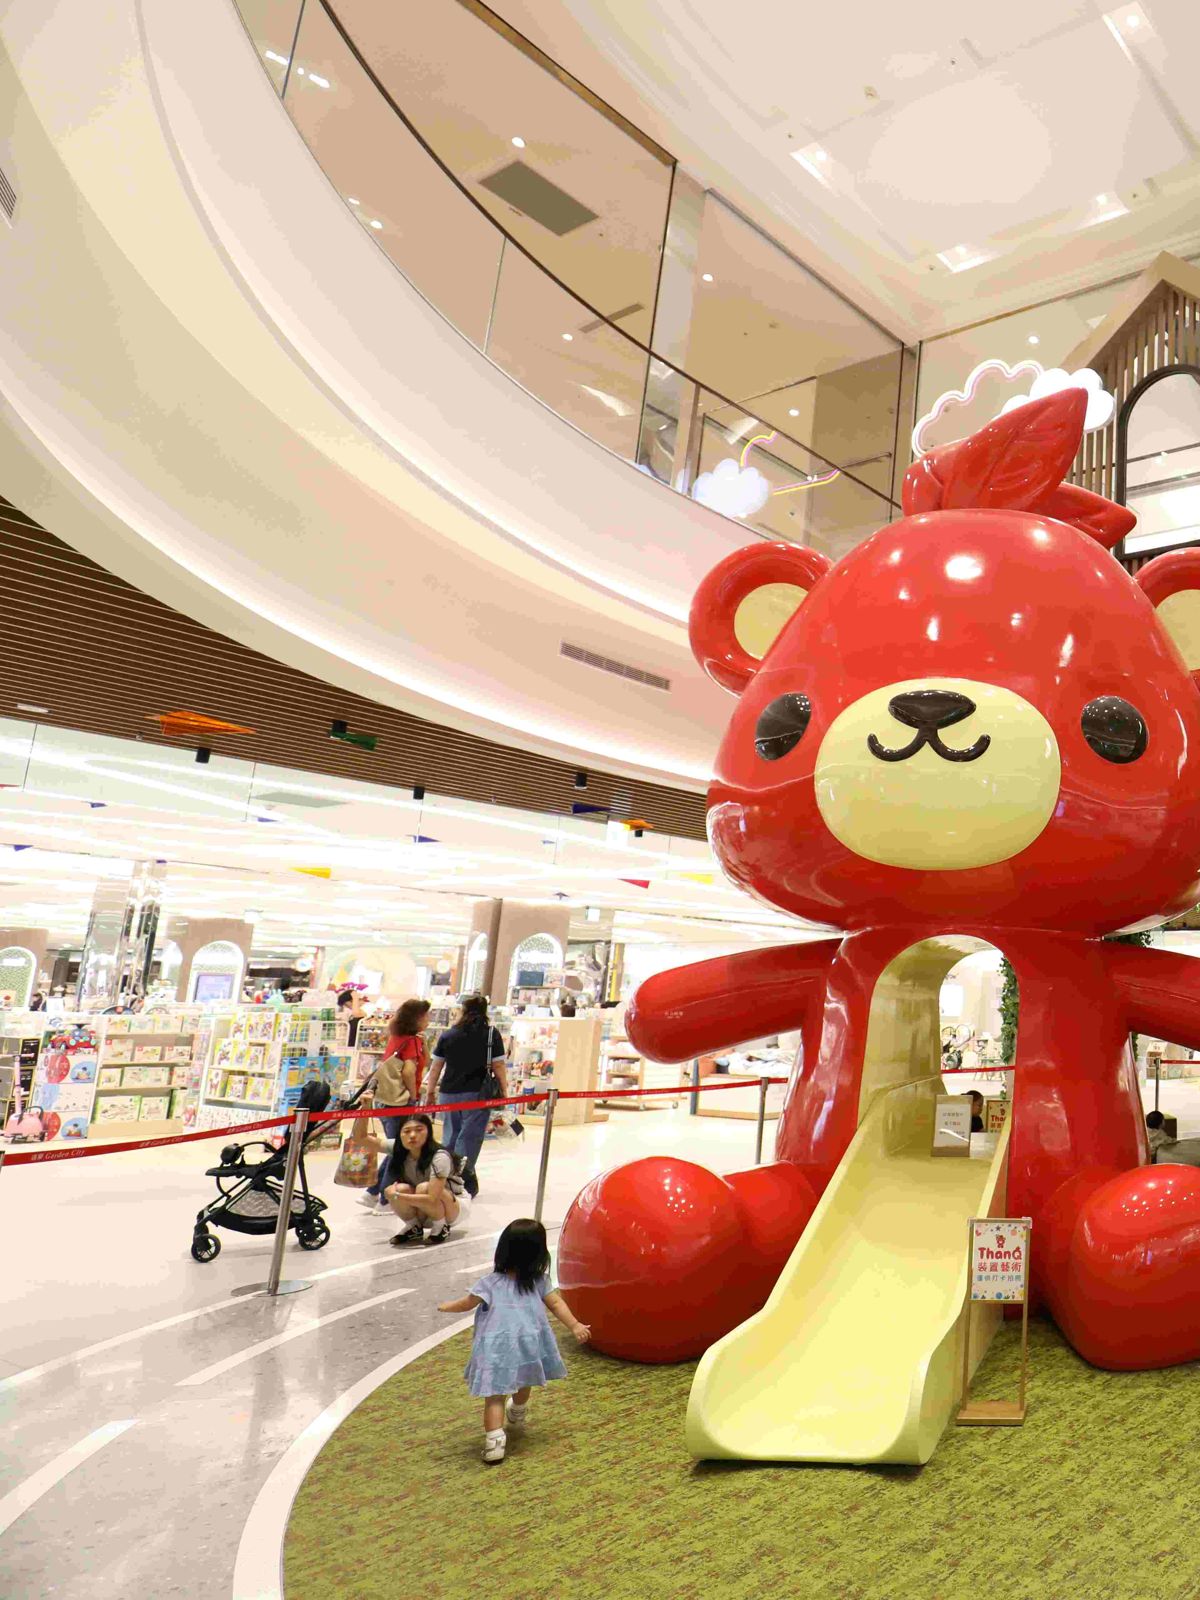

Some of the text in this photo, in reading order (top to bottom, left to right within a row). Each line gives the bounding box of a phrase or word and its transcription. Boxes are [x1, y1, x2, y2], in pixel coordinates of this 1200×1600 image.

[45, 1151, 69, 1160] Garden
[71, 1149, 85, 1157] City
[978, 1246, 1022, 1260] ThanQ
[978, 1262, 1022, 1272] 裝置藝術
